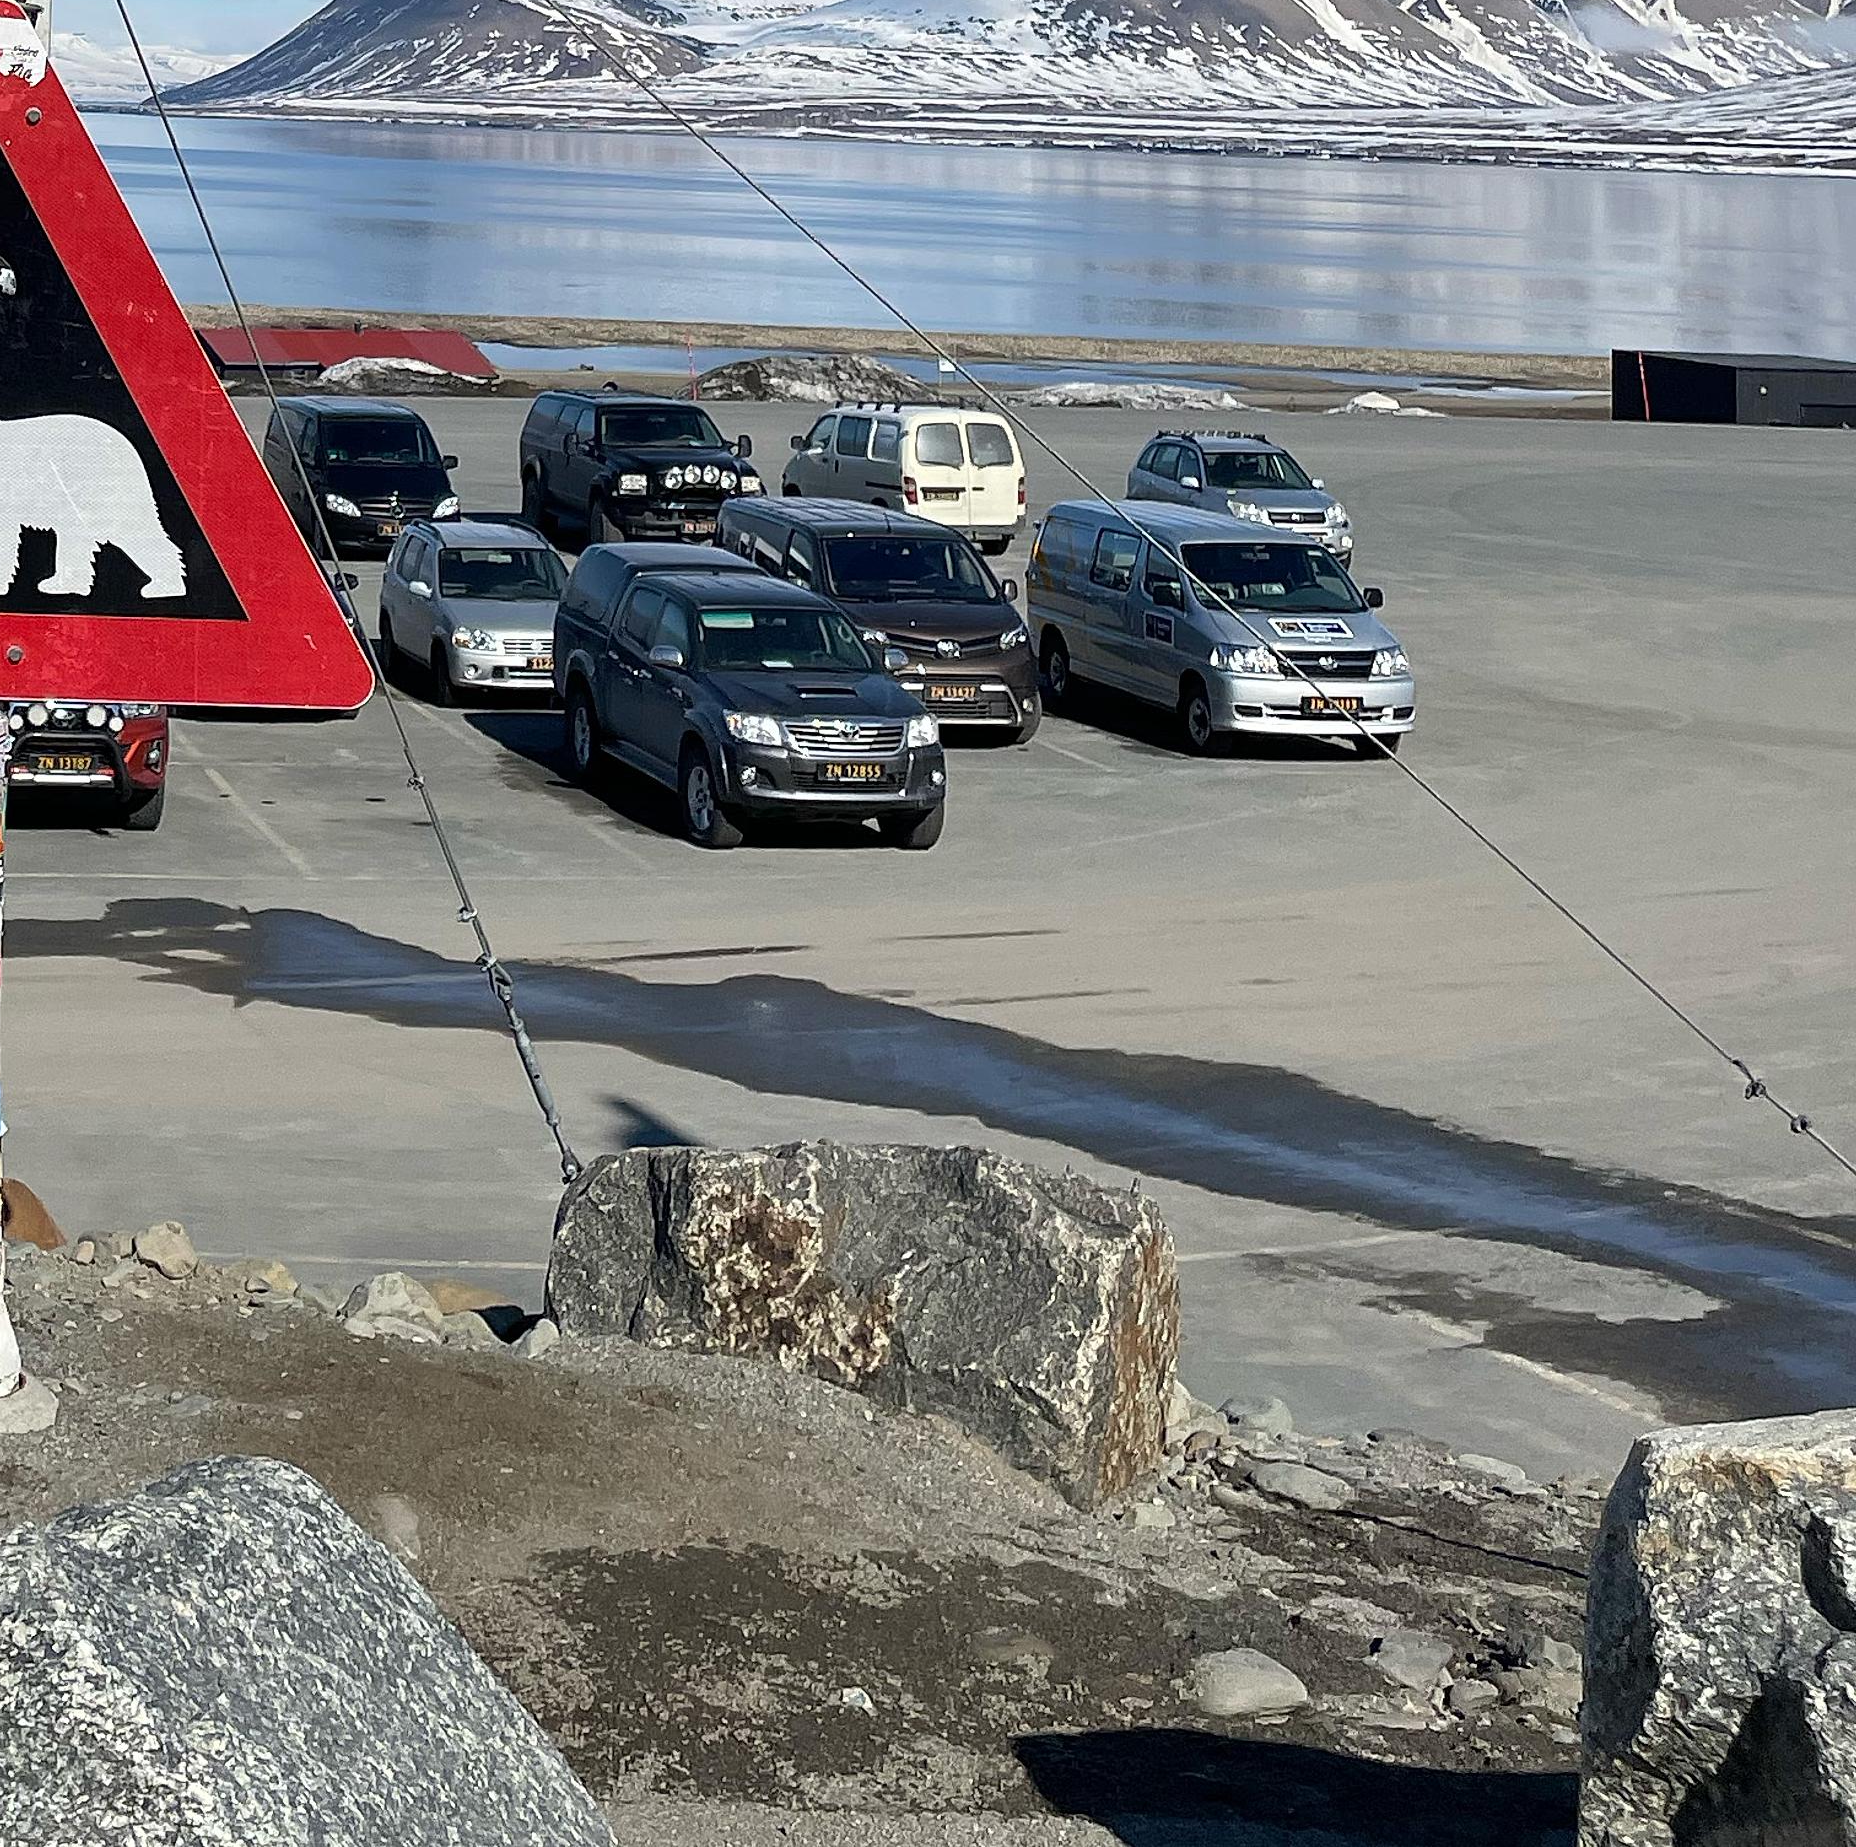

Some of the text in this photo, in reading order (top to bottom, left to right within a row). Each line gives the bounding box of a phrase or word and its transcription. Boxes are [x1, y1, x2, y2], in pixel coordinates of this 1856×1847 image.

[37, 756, 55, 770] ZN
[825, 763, 881, 778] ZN 12855
